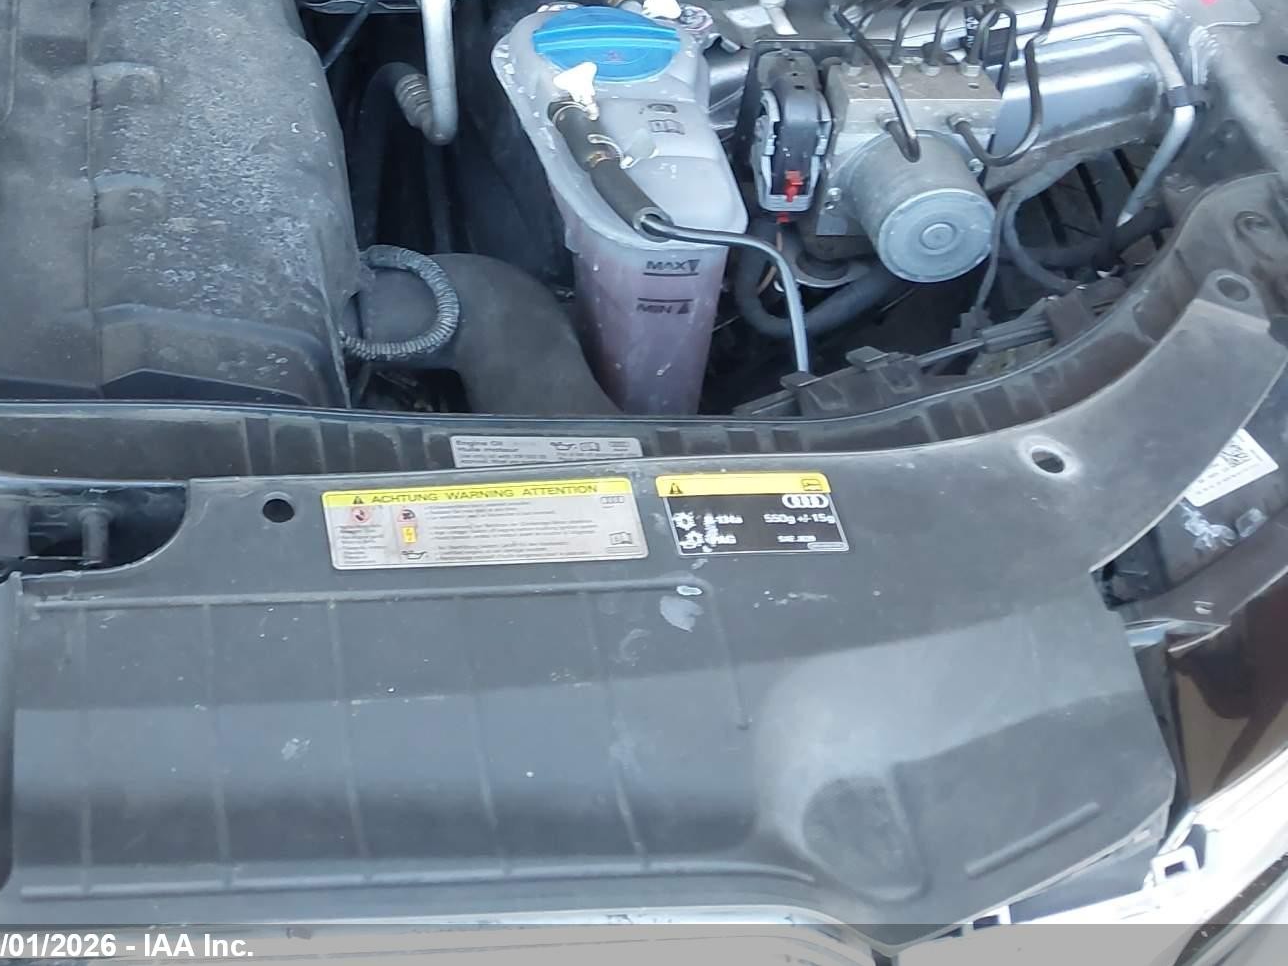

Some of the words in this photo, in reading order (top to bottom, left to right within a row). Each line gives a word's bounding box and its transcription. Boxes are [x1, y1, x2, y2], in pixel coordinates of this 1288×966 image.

[646, 260, 687, 270] MAX
[635, 303, 673, 314] MIN
[371, 493, 438, 503] ACHTUNG
[446, 490, 515, 500] WARNING
[522, 484, 598, 496] ATTENTION
